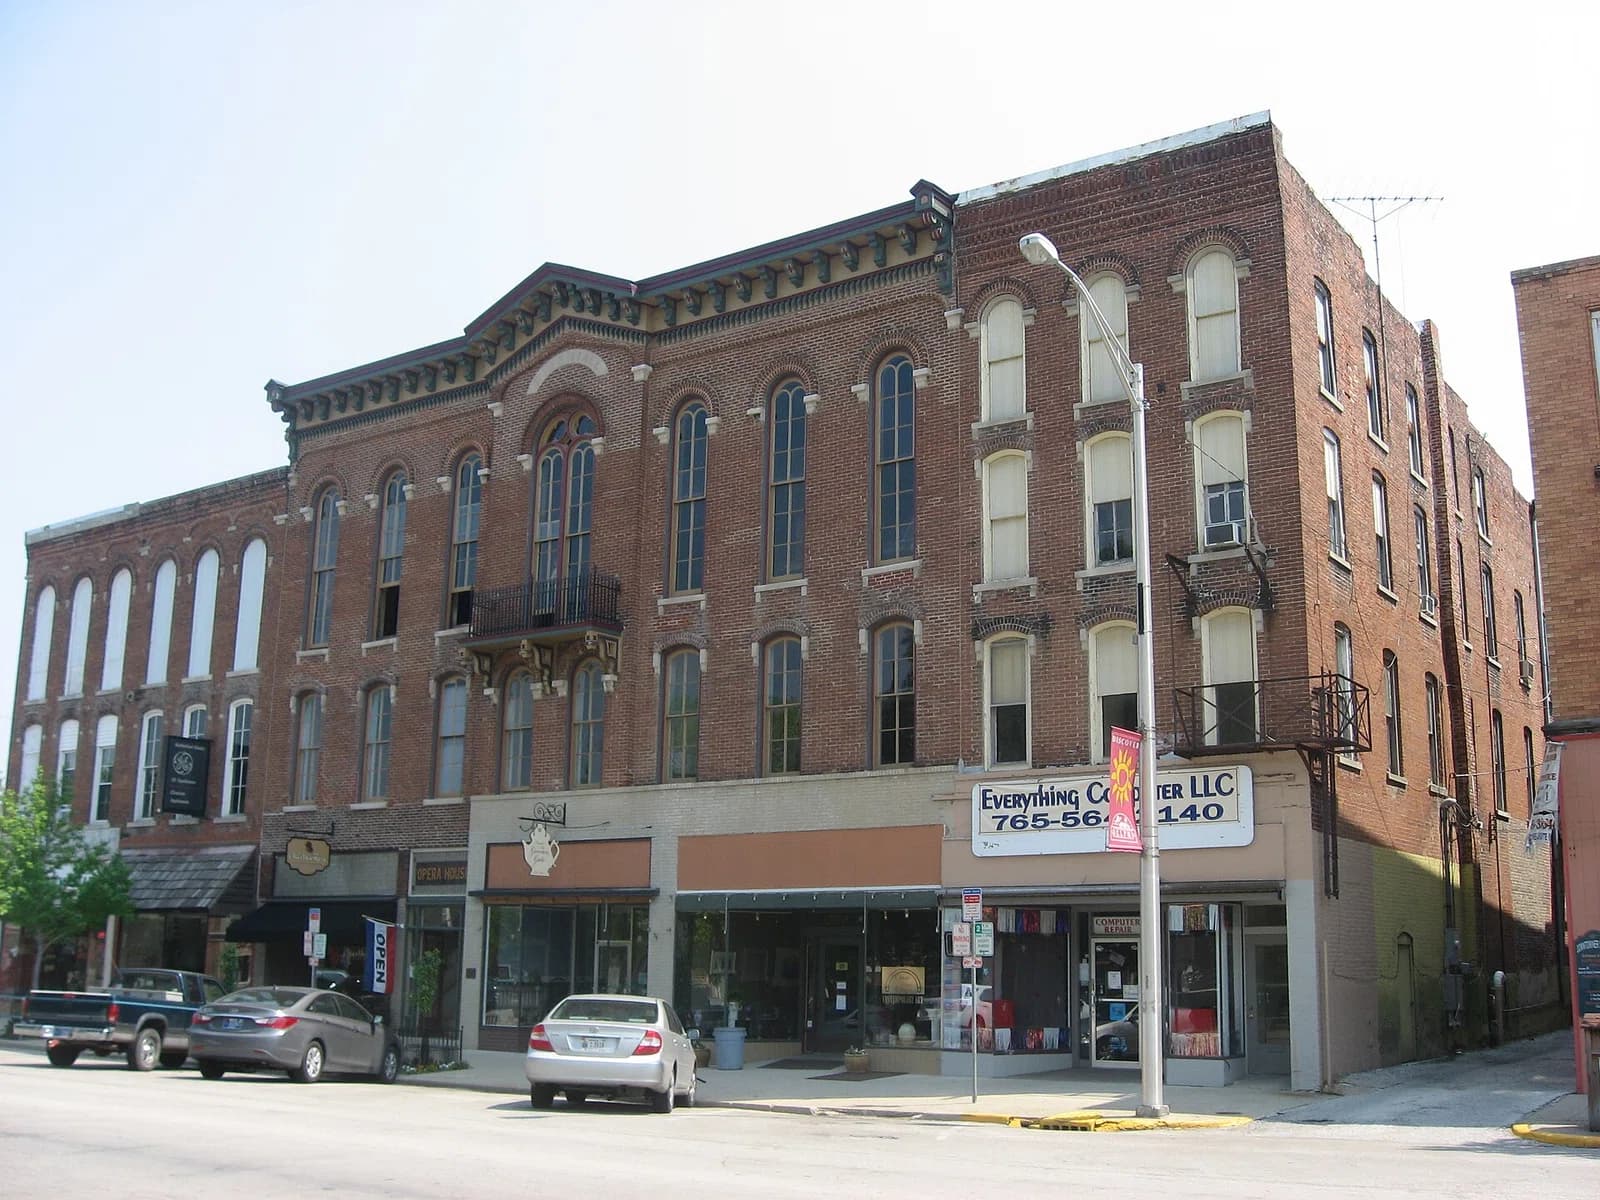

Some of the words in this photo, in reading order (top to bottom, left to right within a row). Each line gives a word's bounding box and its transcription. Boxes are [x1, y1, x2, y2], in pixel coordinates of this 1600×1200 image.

[1190, 773, 1235, 798] LLC
[417, 866, 442, 881] OPERA
[1095, 918, 1141, 926] COMPUTER
[1104, 926, 1132, 934] REPAIR
[375, 933, 386, 984] OPEN
